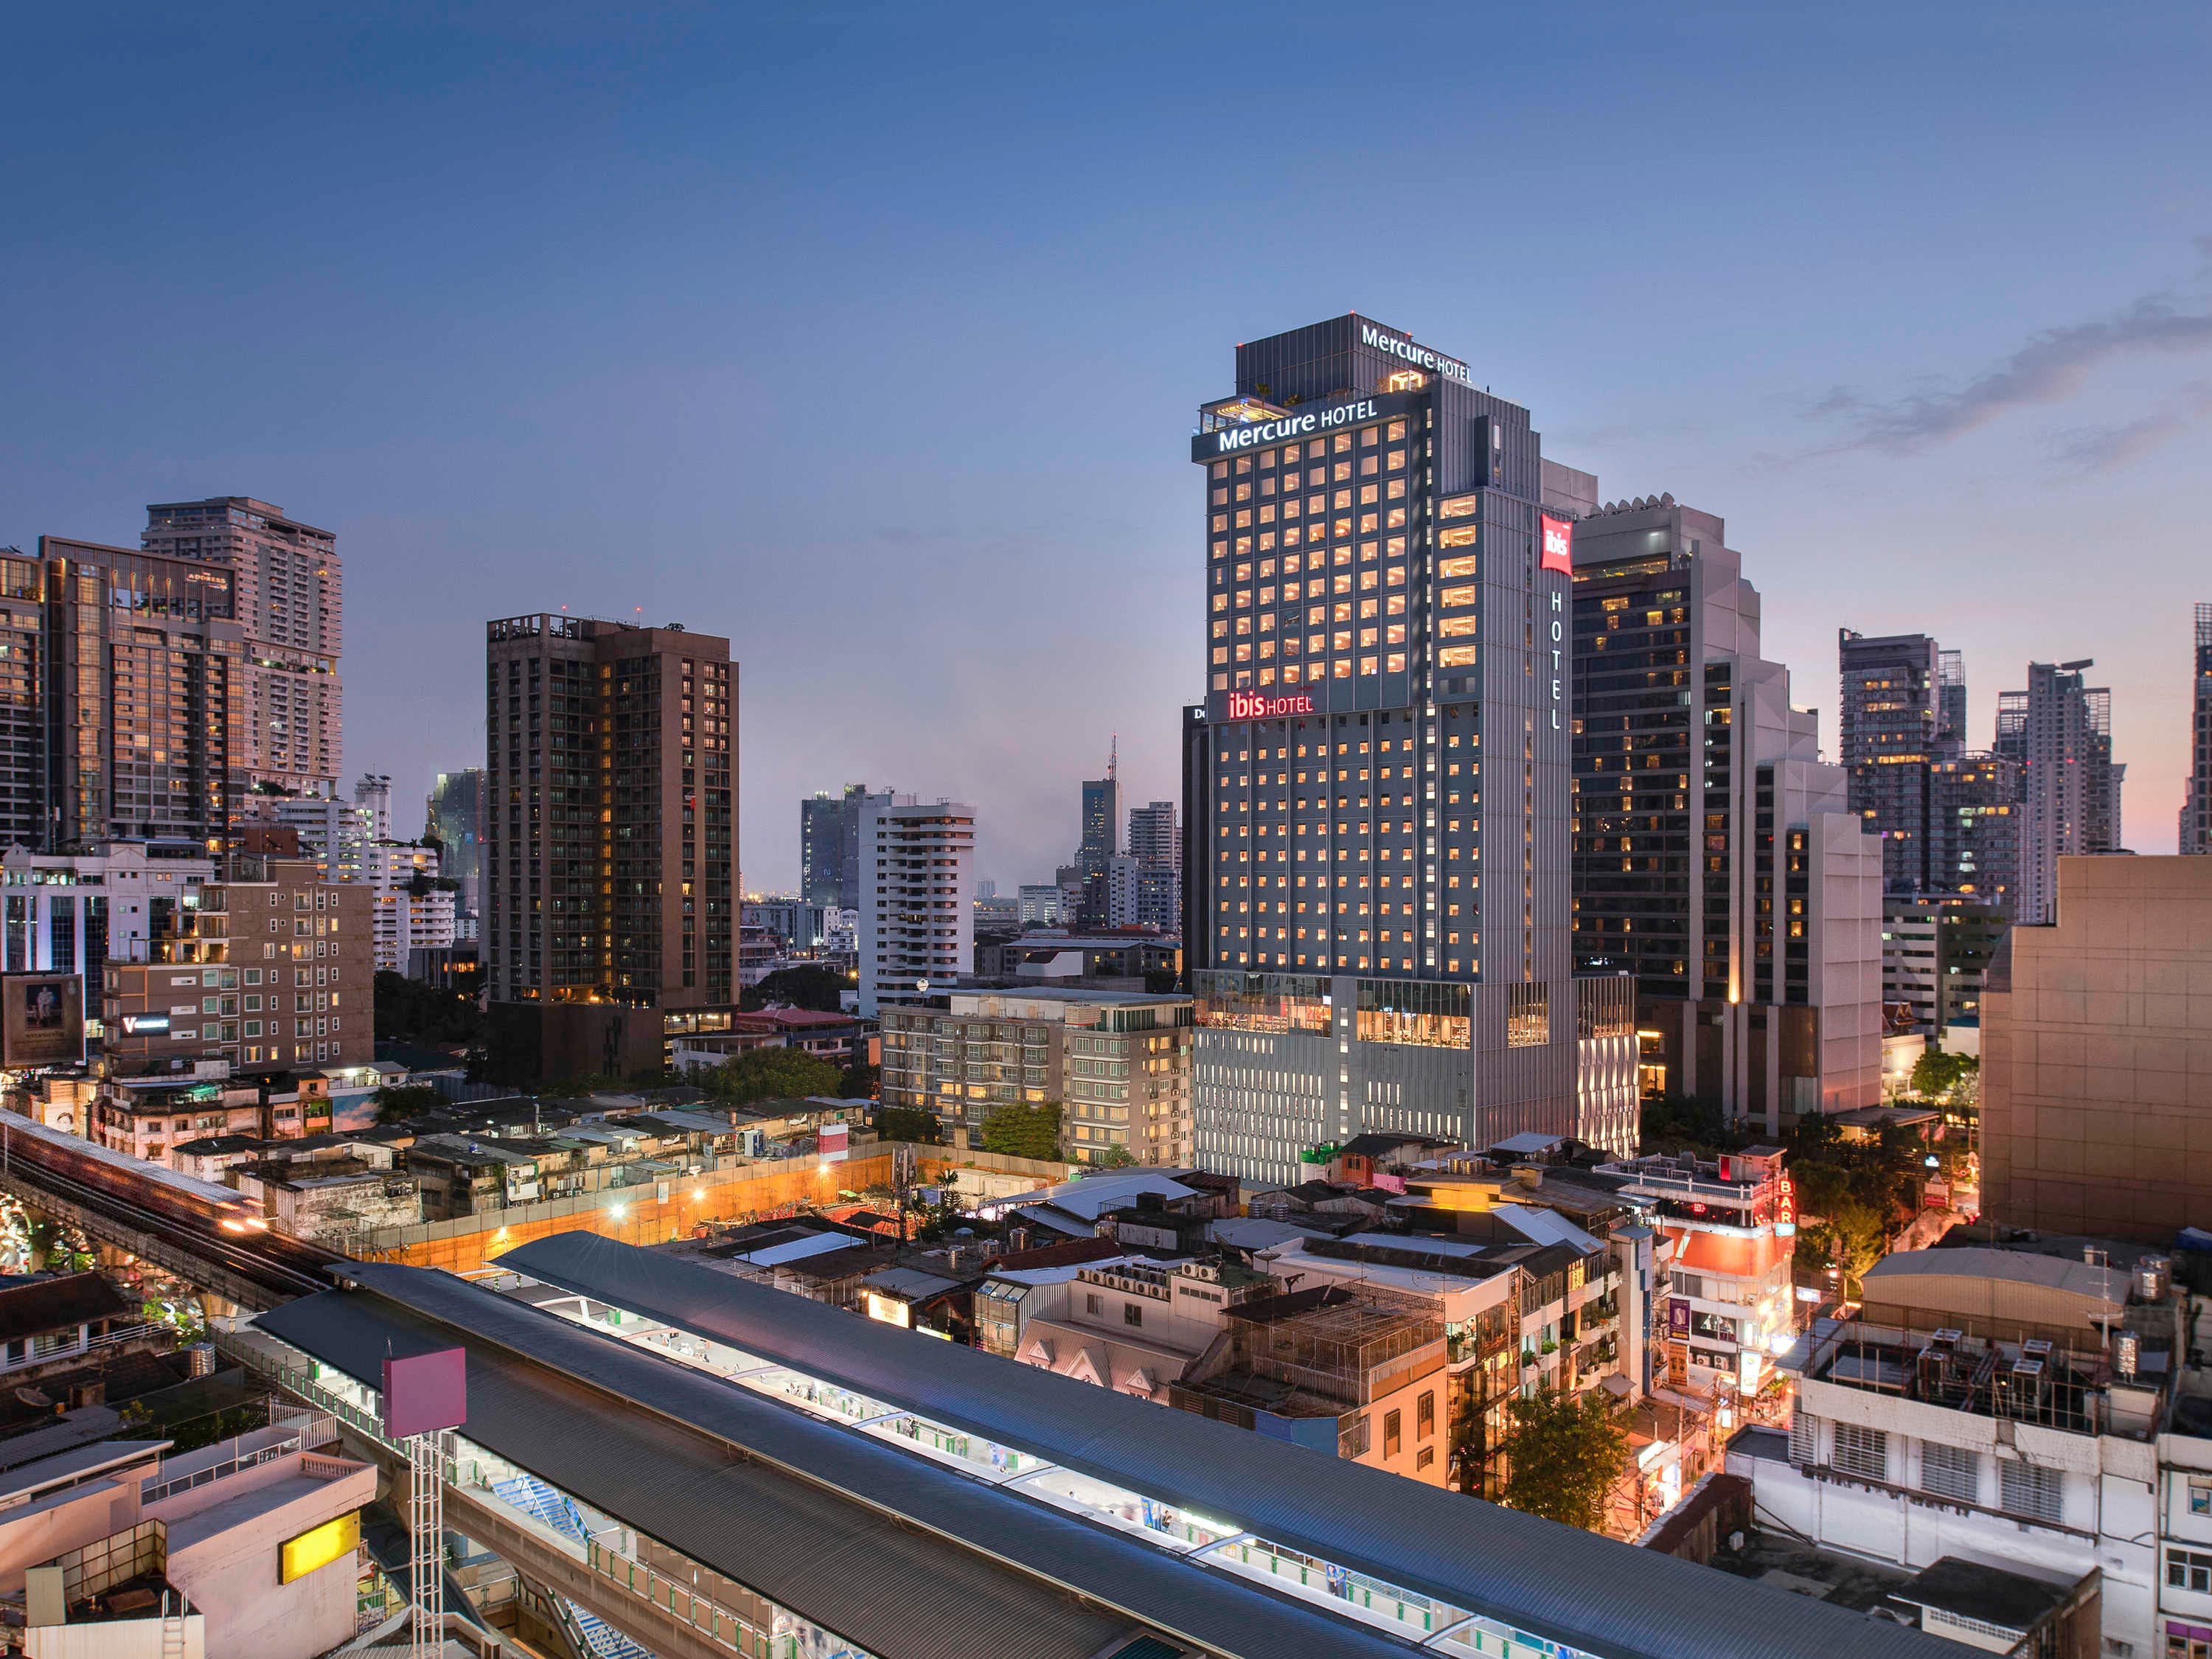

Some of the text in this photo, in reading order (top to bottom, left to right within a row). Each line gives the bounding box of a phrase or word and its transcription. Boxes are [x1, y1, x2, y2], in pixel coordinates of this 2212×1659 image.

[1362, 324, 1472, 384] Mercure HOTEL
[1219, 399, 1378, 452] Mercure HOTEL
[1545, 529, 1568, 557] ibis
[1551, 591, 1562, 730] HOTEL
[1229, 690, 1315, 718] ibis HOTEL
[1780, 1180, 1792, 1223] BAR
